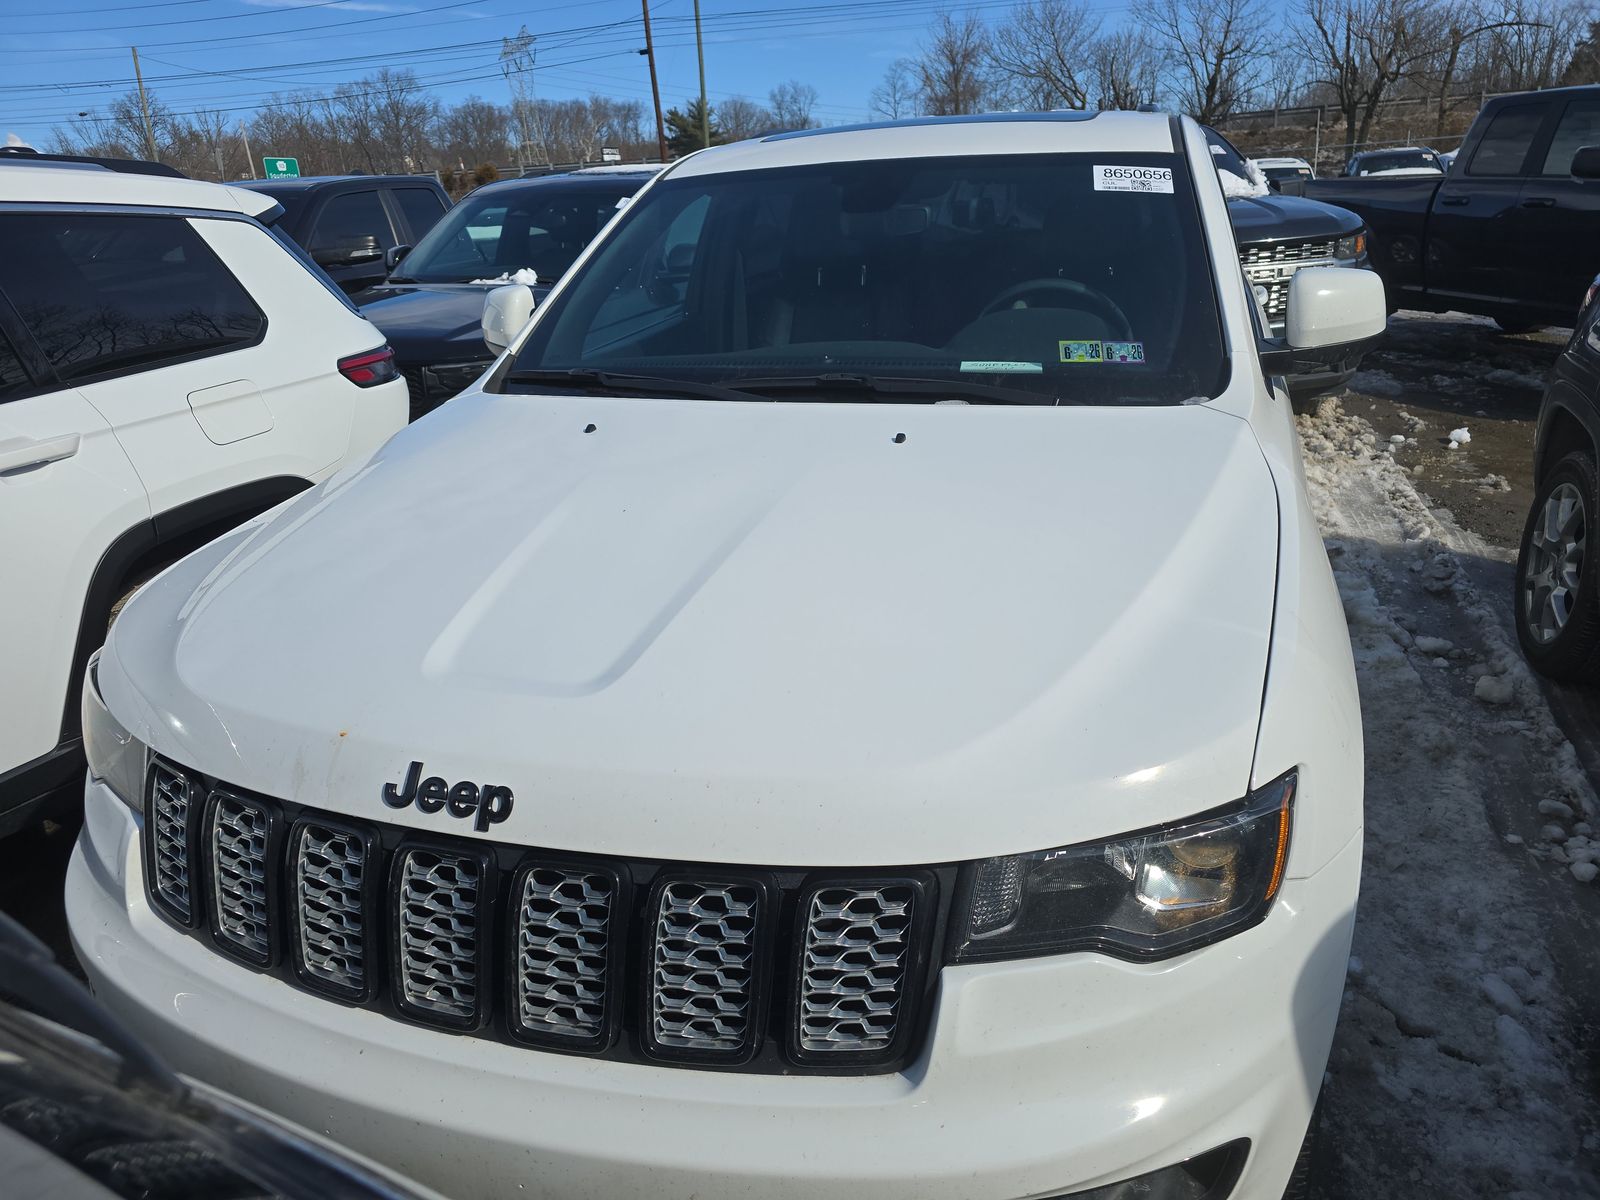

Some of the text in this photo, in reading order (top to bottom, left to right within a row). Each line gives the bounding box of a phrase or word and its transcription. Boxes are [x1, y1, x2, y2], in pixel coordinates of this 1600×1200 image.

[1103, 168, 1172, 181] 8650656
[1064, 343, 1101, 360] 6 26
[1106, 344, 1143, 361] 6 26
[382, 761, 514, 833] Jeep
